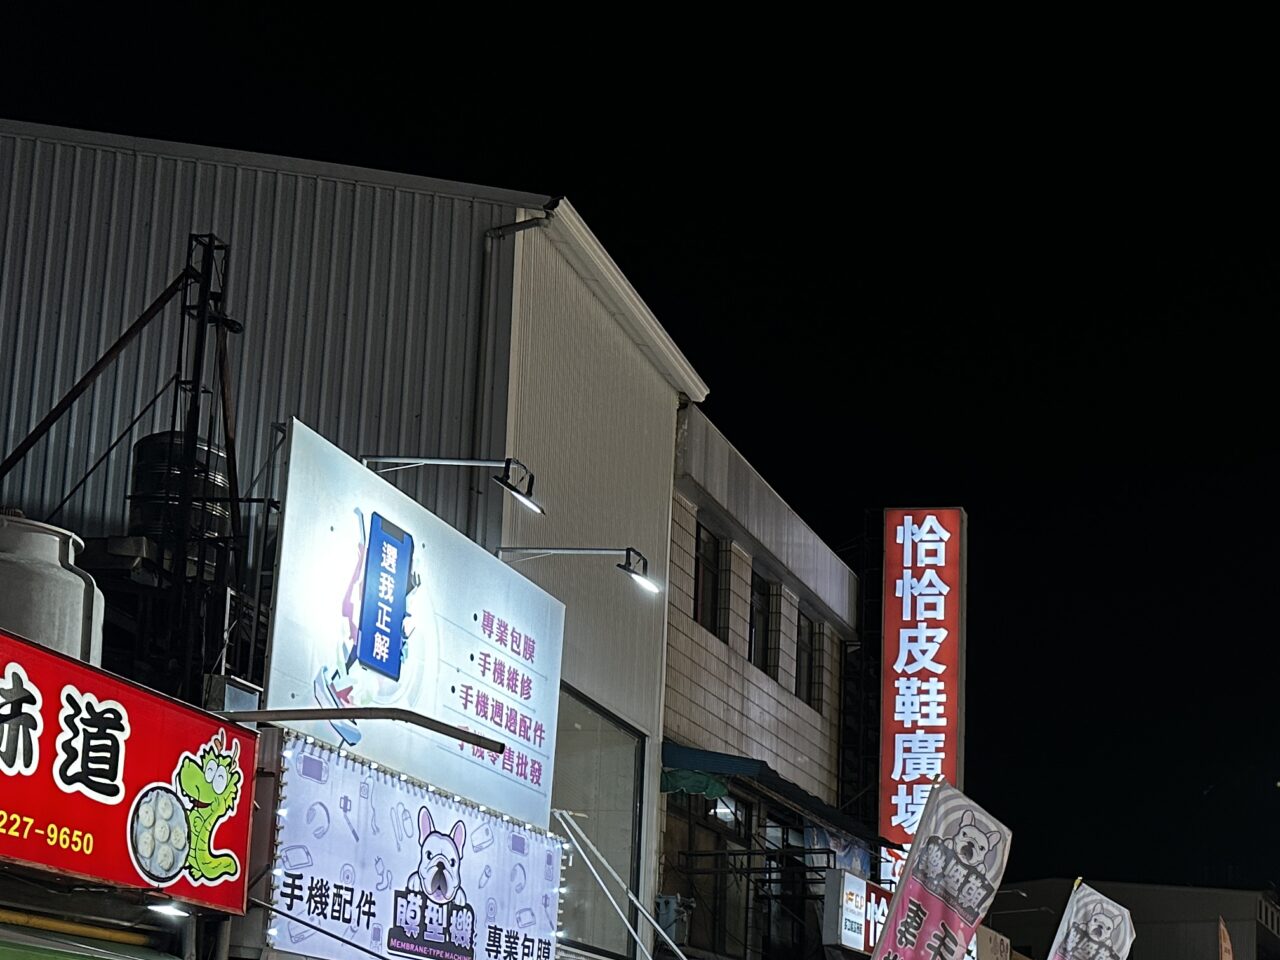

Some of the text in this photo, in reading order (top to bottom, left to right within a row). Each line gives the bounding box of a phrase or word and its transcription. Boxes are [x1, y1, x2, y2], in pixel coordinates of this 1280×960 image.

[373, 541, 398, 663] 選我正解
[480, 609, 536, 665] 專業包膜
[477, 651, 533, 701] 手機維修
[891, 515, 951, 836] 恰恰皮鞋廣場
[0, 810, 94, 855] 227-9650
[280, 872, 377, 931] 手機配件
